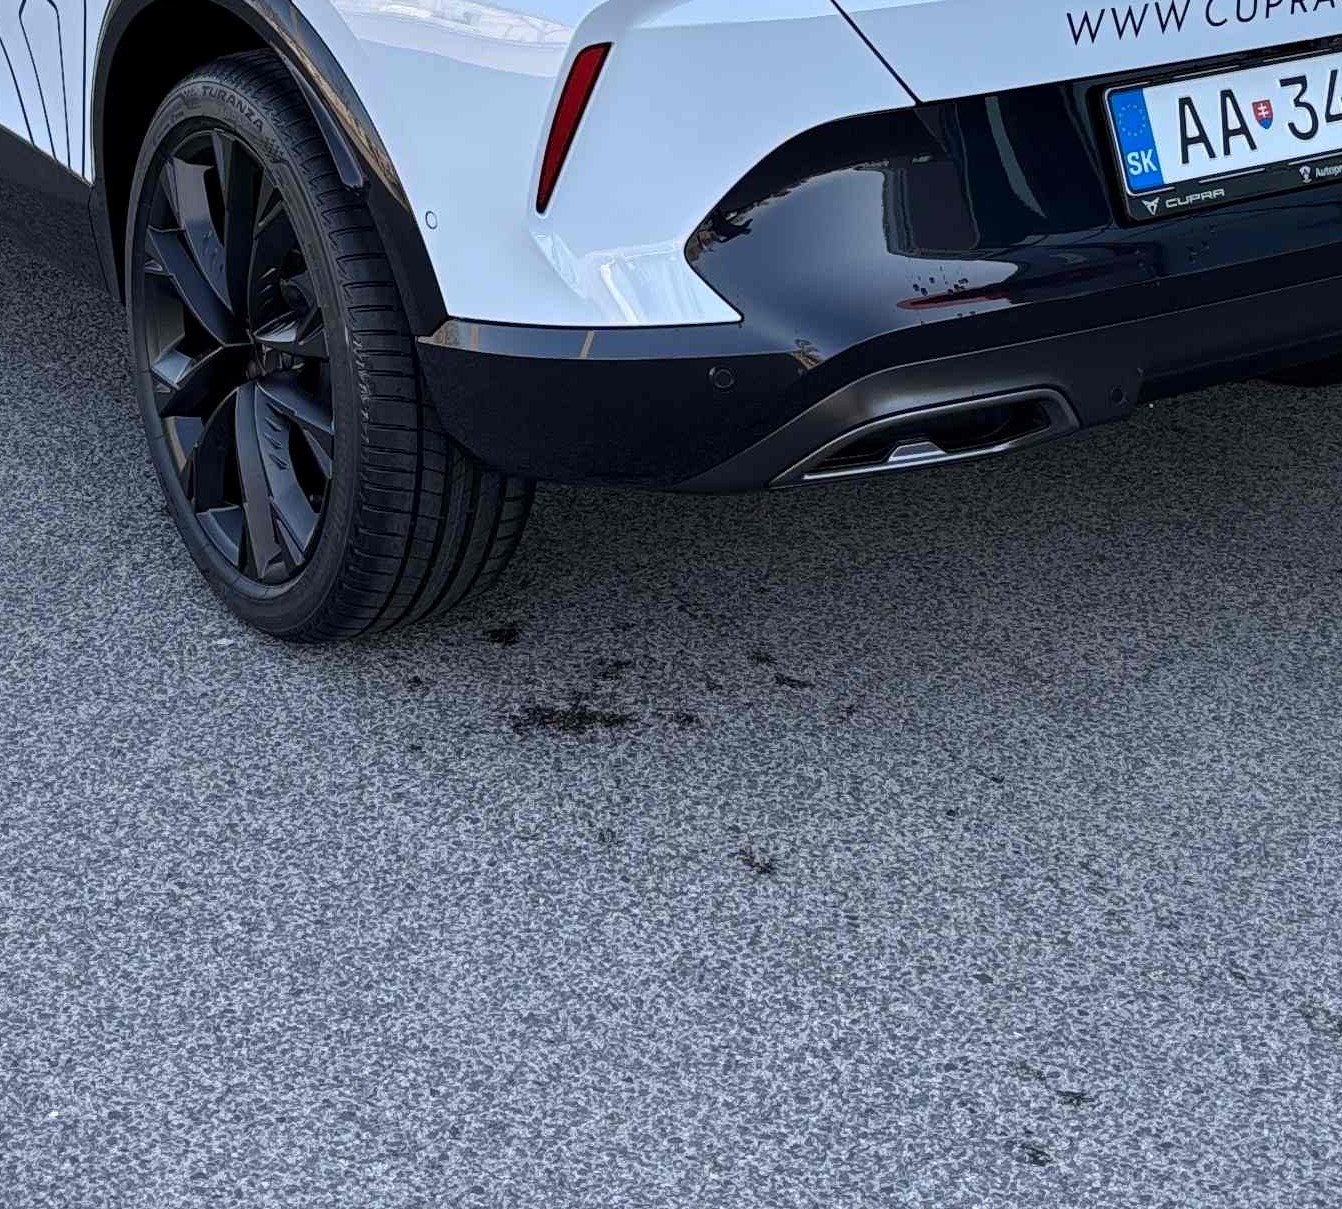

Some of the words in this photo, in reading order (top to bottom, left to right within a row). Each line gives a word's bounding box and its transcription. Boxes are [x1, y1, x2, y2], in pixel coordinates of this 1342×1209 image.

[202, 85, 263, 133] TURANZA
[1127, 148, 1158, 176] SK
[1165, 188, 1225, 208] CUPRA
